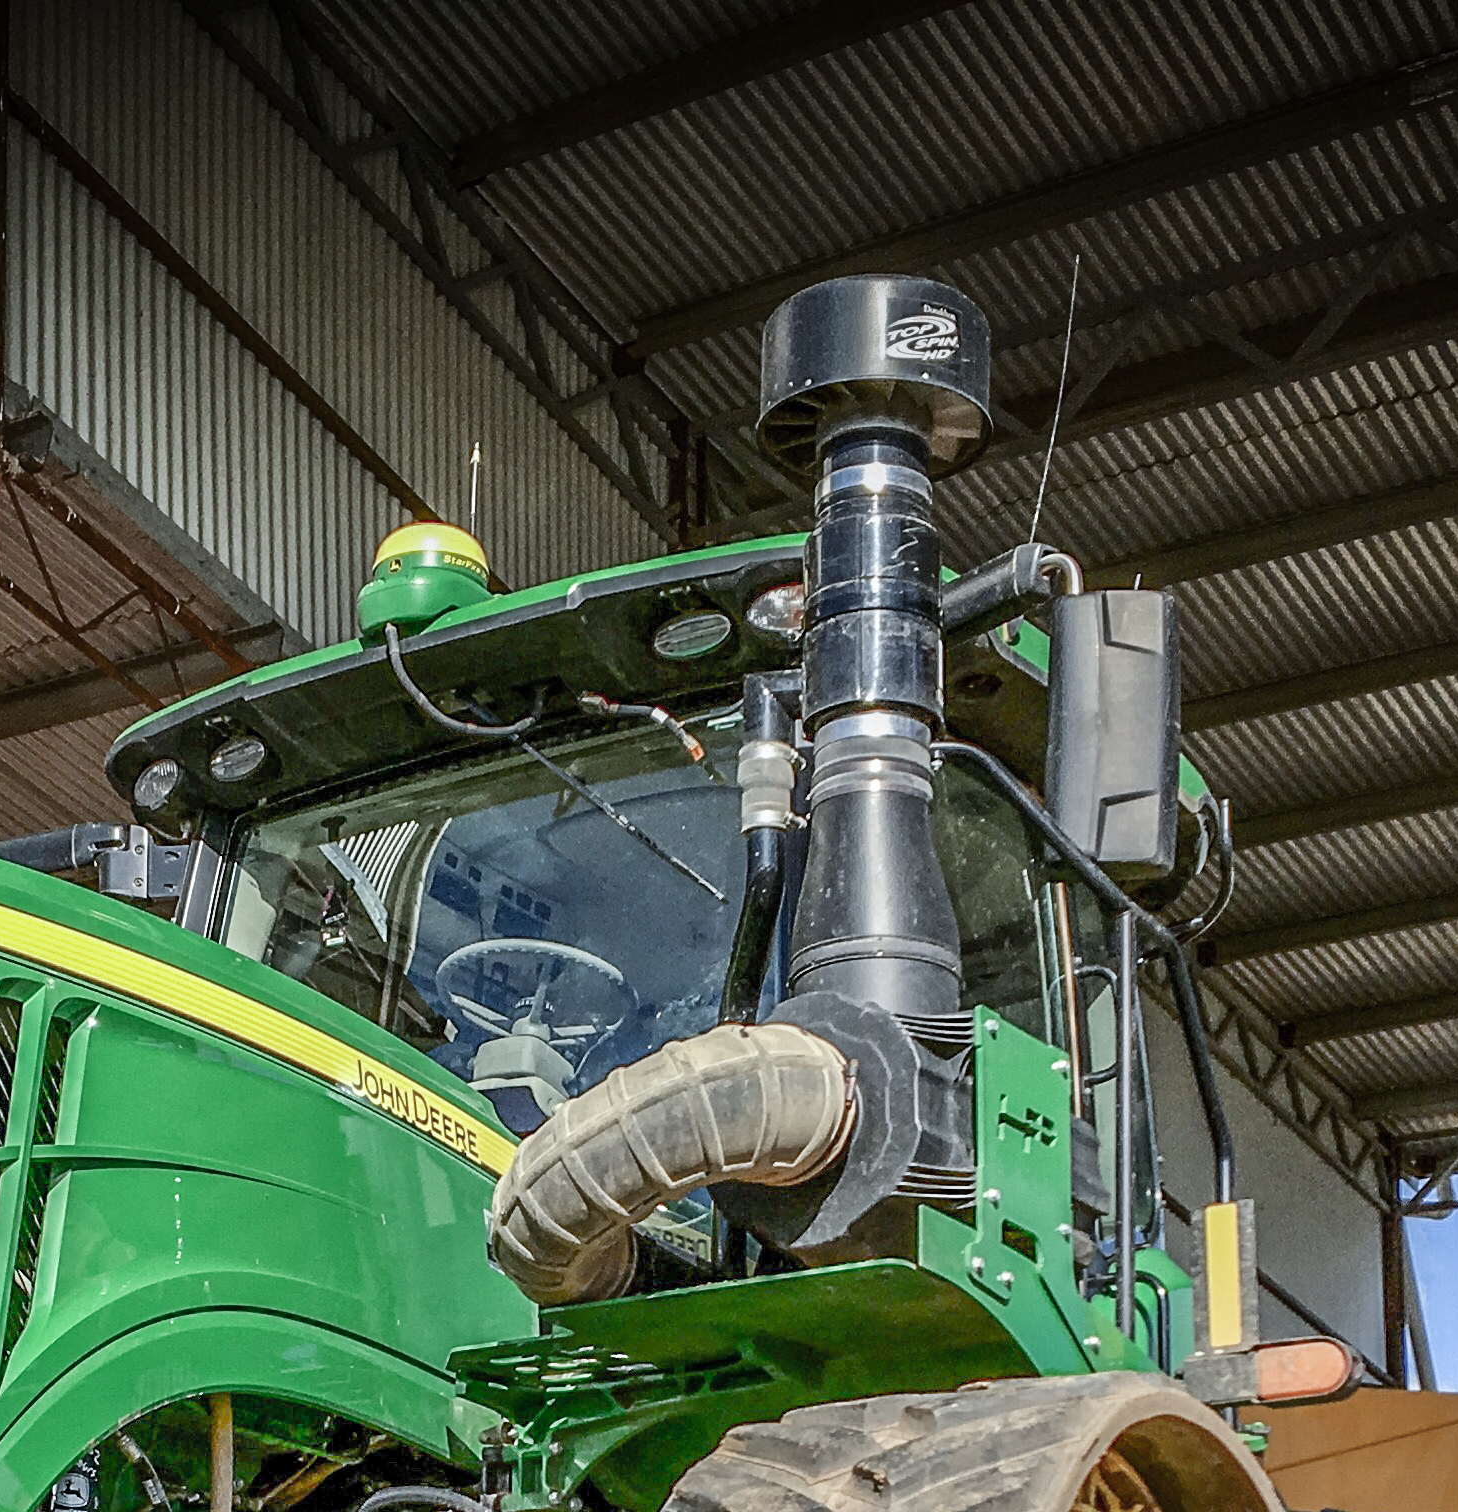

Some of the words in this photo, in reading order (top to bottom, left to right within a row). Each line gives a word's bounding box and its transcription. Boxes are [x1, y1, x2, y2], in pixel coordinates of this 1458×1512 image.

[887, 323, 934, 341] TOP
[914, 335, 958, 350] SPIN
[922, 349, 952, 360] HD
[352, 1059, 410, 1118] JOHN
[413, 1089, 479, 1159] DEERE
